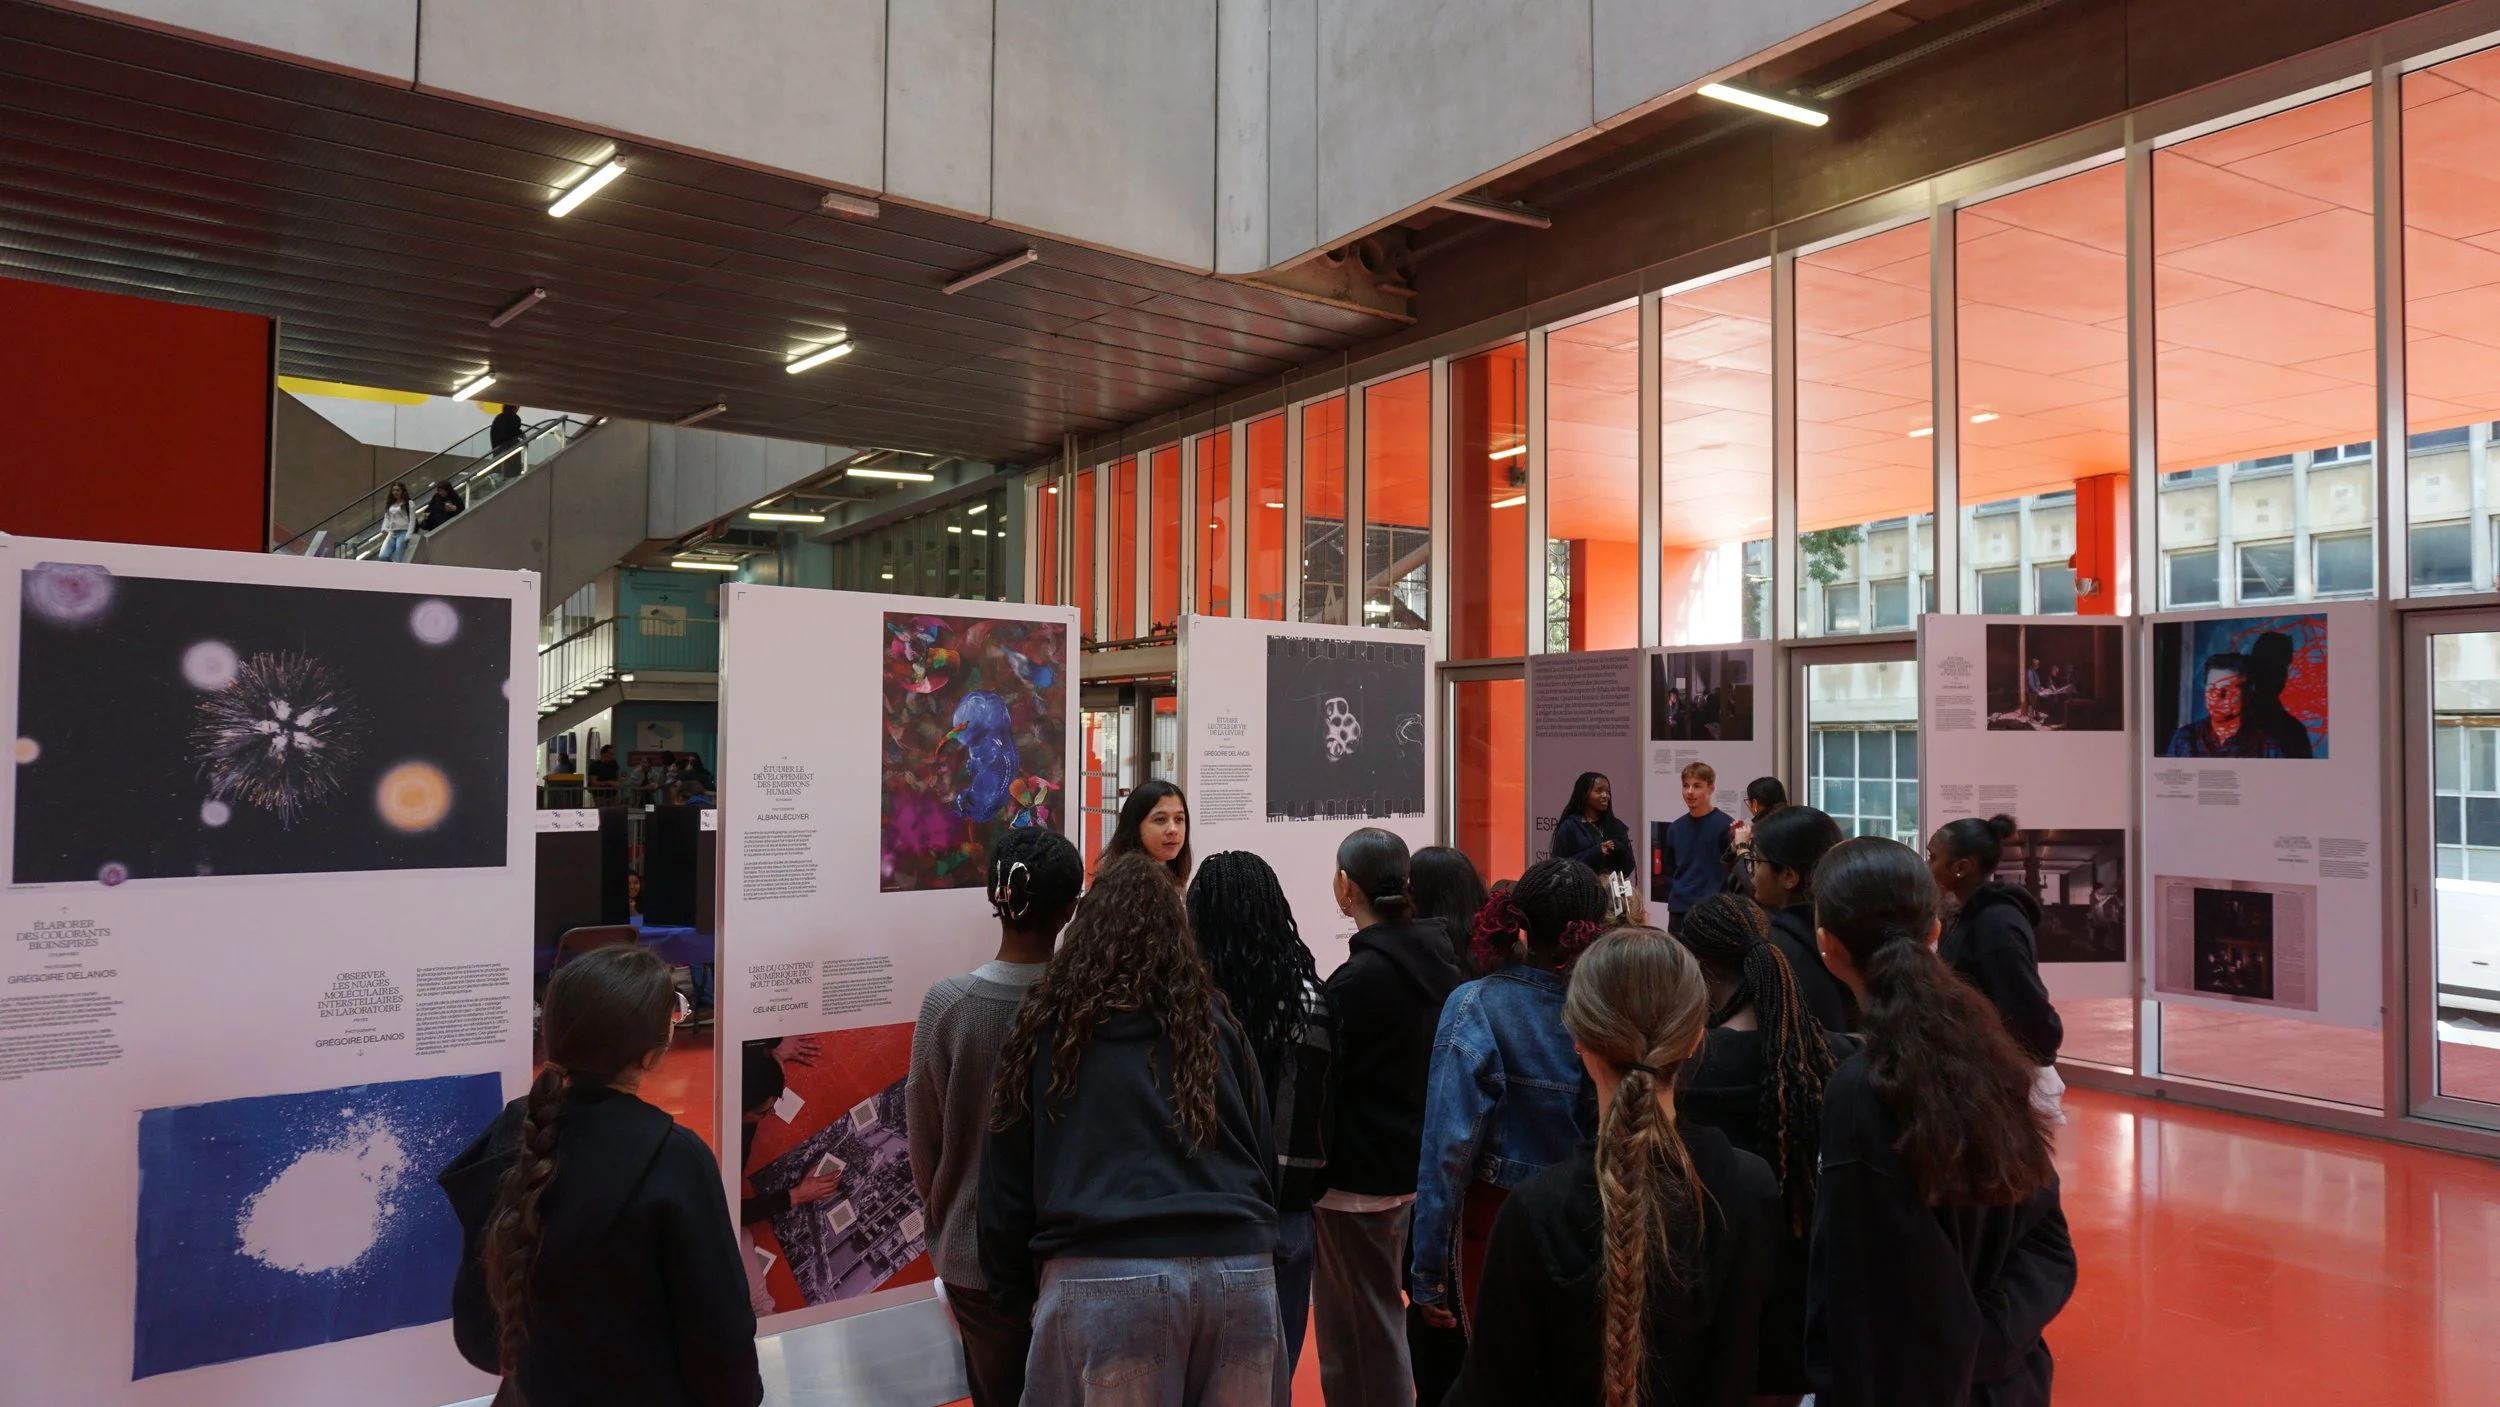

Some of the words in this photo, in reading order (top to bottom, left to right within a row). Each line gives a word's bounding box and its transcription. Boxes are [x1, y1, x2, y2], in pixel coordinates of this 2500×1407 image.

[763, 764, 795, 773] ÉTUDIER
[795, 765, 805, 773] LE
[753, 772, 814, 781] DÉVELOPPEMENT
[757, 780, 771, 788] DES
[772, 780, 811, 788] EMBRYONS
[766, 788, 802, 796] HUMAINS
[757, 813, 779, 821] ALBAN
[33, 919, 95, 931] ÉLABORER
[16, 931, 39, 941] DES
[40, 928, 111, 940] COLORANTS
[28, 937, 99, 950] BIOINSPIRÉS
[748, 965, 765, 974] LIRE
[766, 964, 777, 972] DU
[777, 961, 814, 971] CONTENU
[798, 969, 810, 977] DU
[7, 972, 65, 984] GRÉGOIRE
[66, 969, 118, 980] DELANOS
[336, 970, 386, 981] OBSERVER
[332, 981, 350, 990] LES
[351, 978, 390, 989] NUAGES
[750, 980, 771, 989] BOUT
[771, 979, 785, 987] DES
[785, 976, 813, 985] DOIGTS
[324, 986, 400, 1000] MOLÉCULAIRES
[317, 995, 404, 1009] INTERSTELLAIRES
[752, 1004, 777, 1014] CÉLINE
[777, 1001, 809, 1012] LECOMTE
[319, 1009, 334, 1018] EN
[335, 1003, 401, 1017] LABORATOIRE
[315, 1036, 362, 1048] GRÉGOIRE
[363, 1032, 405, 1044] DELANOS
